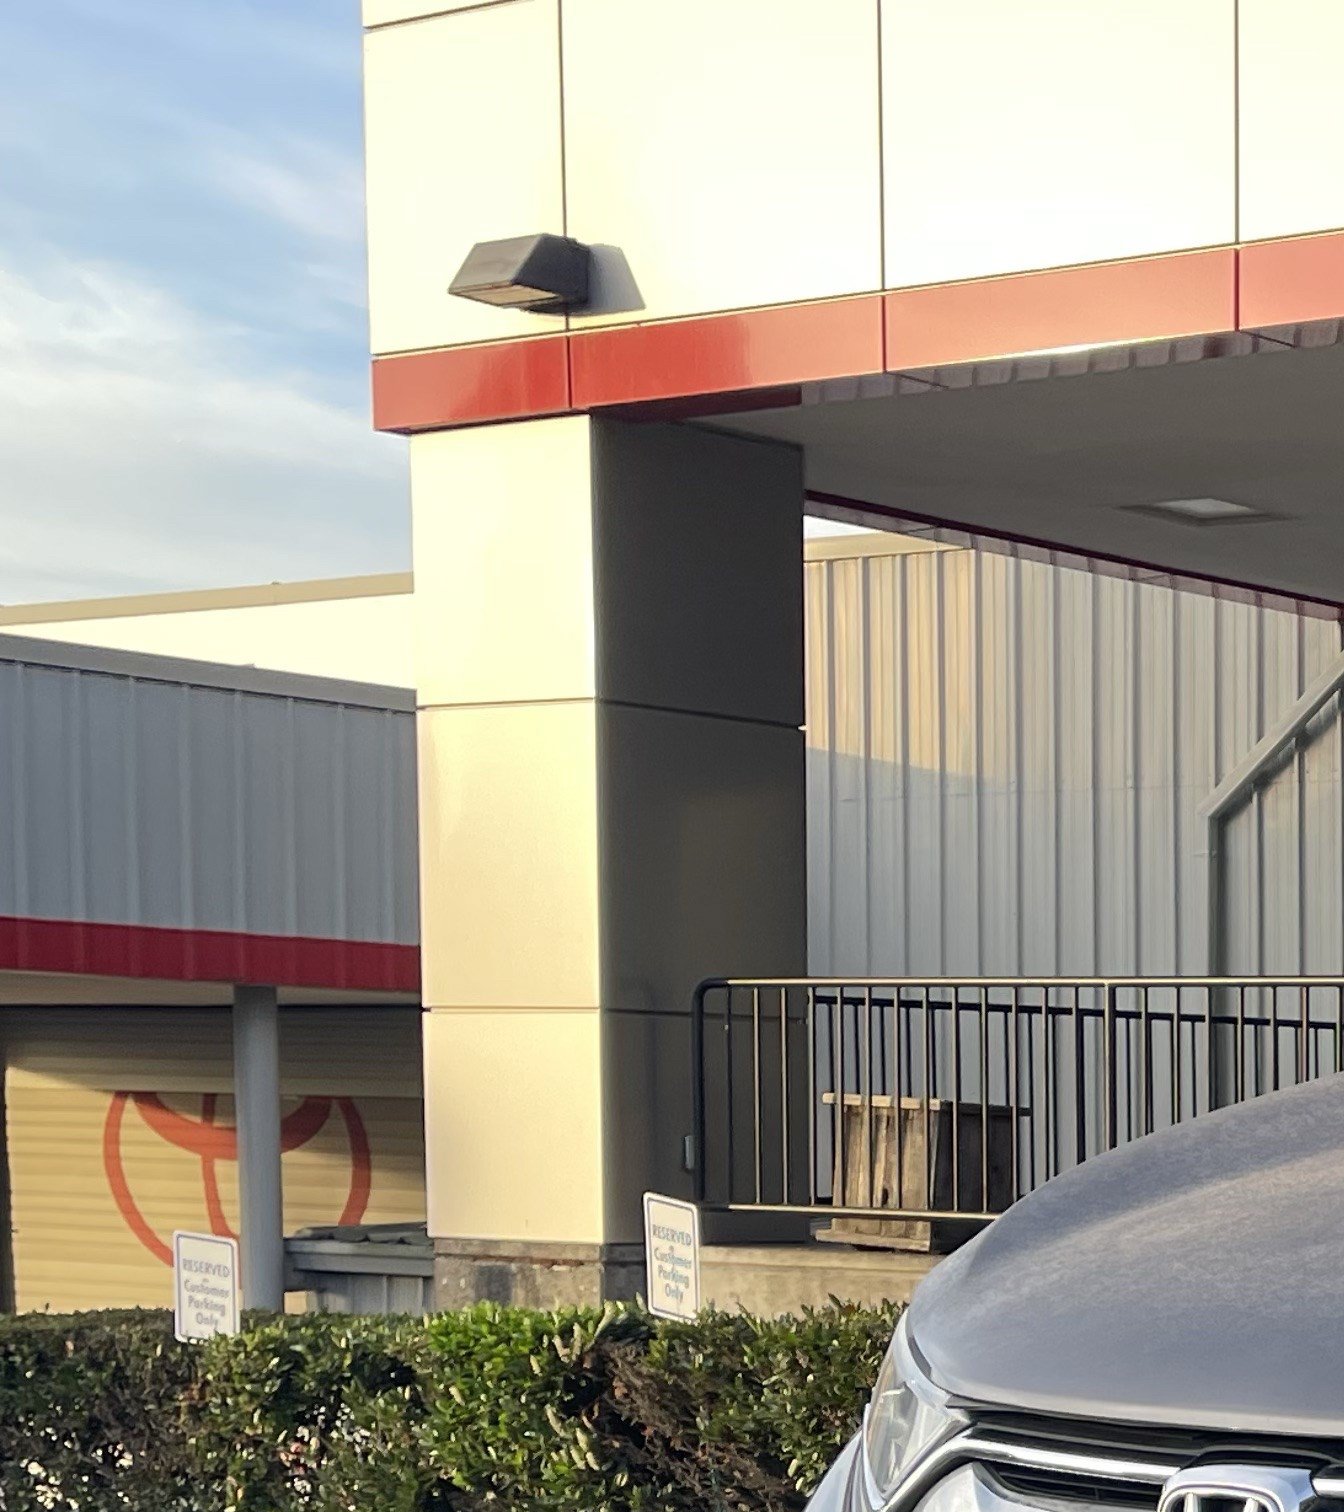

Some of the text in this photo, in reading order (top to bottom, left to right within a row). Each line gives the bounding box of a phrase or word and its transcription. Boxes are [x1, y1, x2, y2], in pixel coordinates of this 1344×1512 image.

[652, 1223, 692, 1246] RESERVED
[182, 1258, 230, 1278] RESERVED
[184, 1279, 230, 1299] Customer
[187, 1295, 225, 1317] Parking
